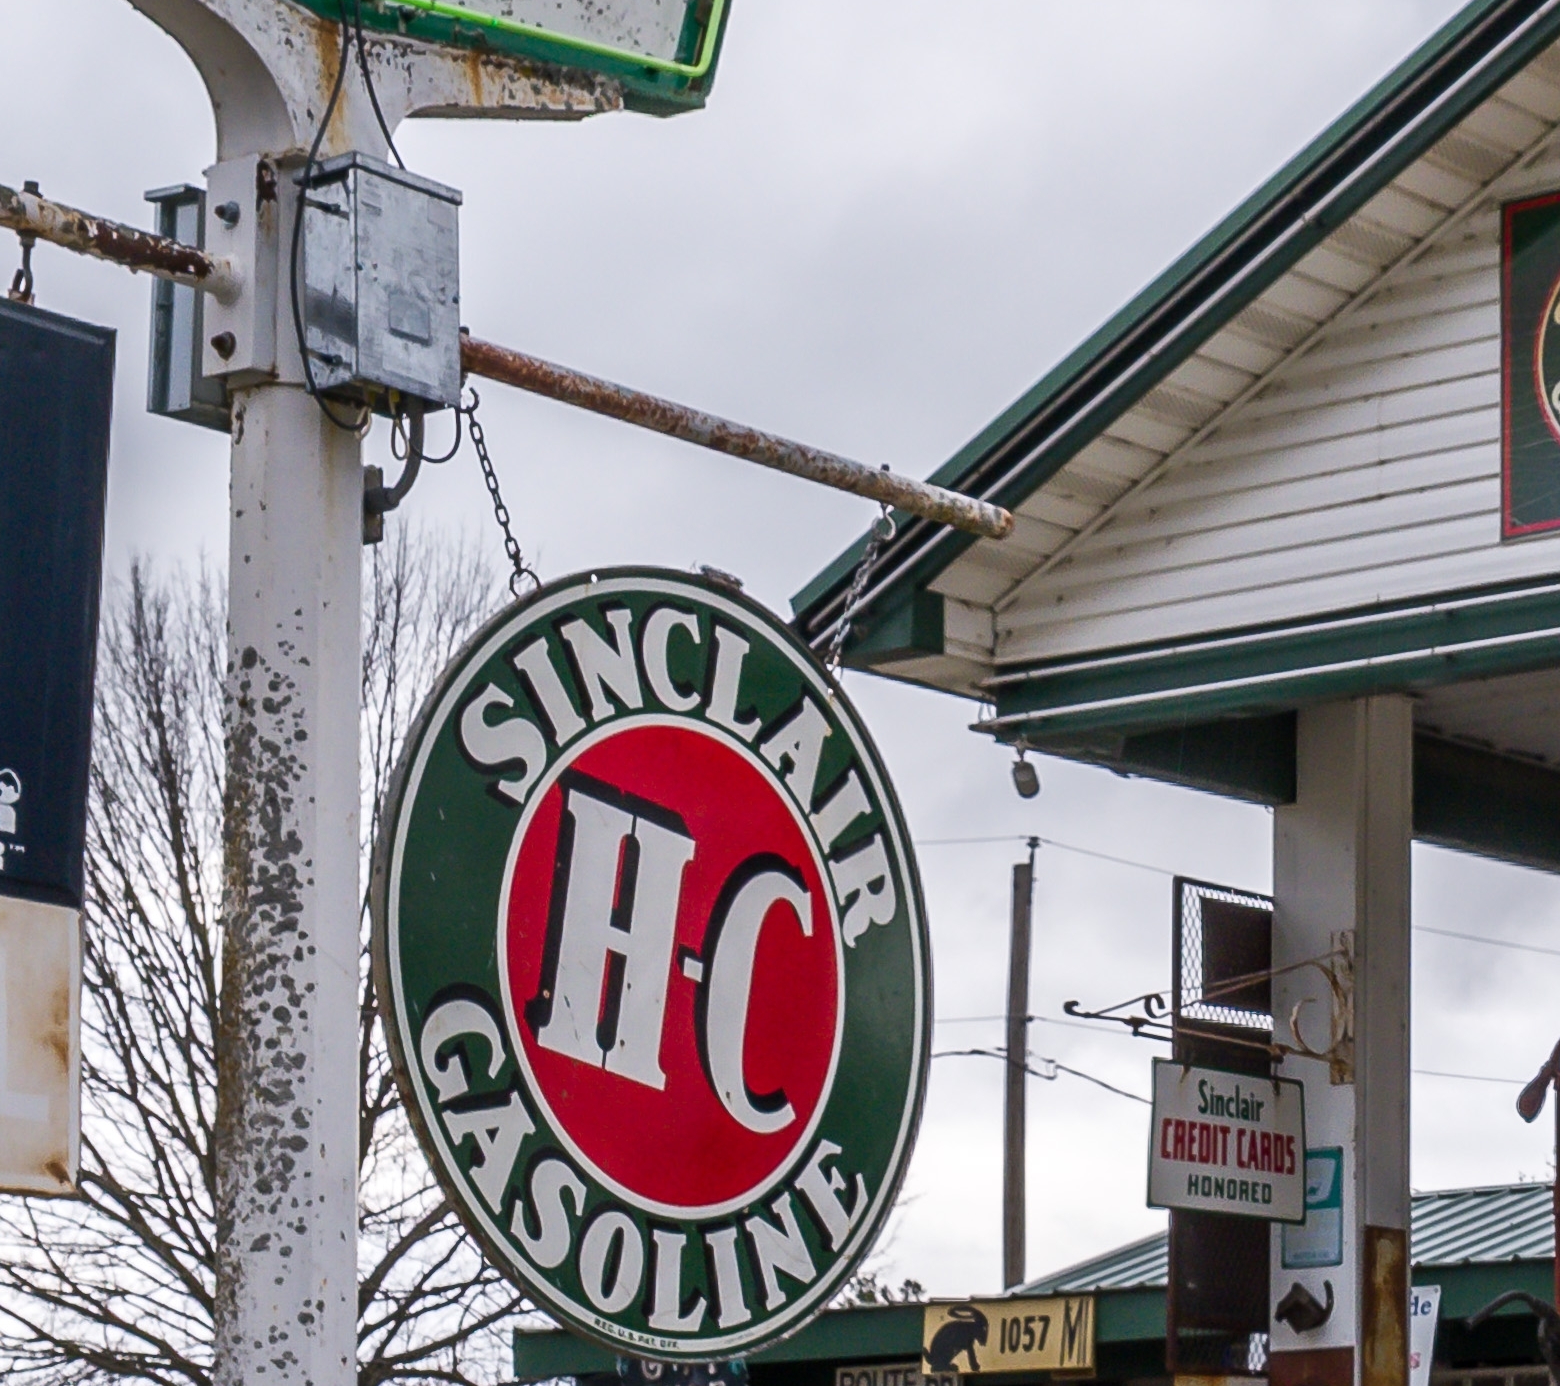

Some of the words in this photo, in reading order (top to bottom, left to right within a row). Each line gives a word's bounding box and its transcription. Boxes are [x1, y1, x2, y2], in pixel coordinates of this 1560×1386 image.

[461, 606, 898, 949] SINCLAIR
[1197, 1078, 1265, 1123] Sinclair
[420, 1000, 870, 1333] GASOLINE
[1160, 1117, 1231, 1166] CREDIT
[1236, 1127, 1296, 1175] CARDS
[1186, 1173, 1272, 1205] HONORED
[999, 1315, 1051, 1355] 1057
